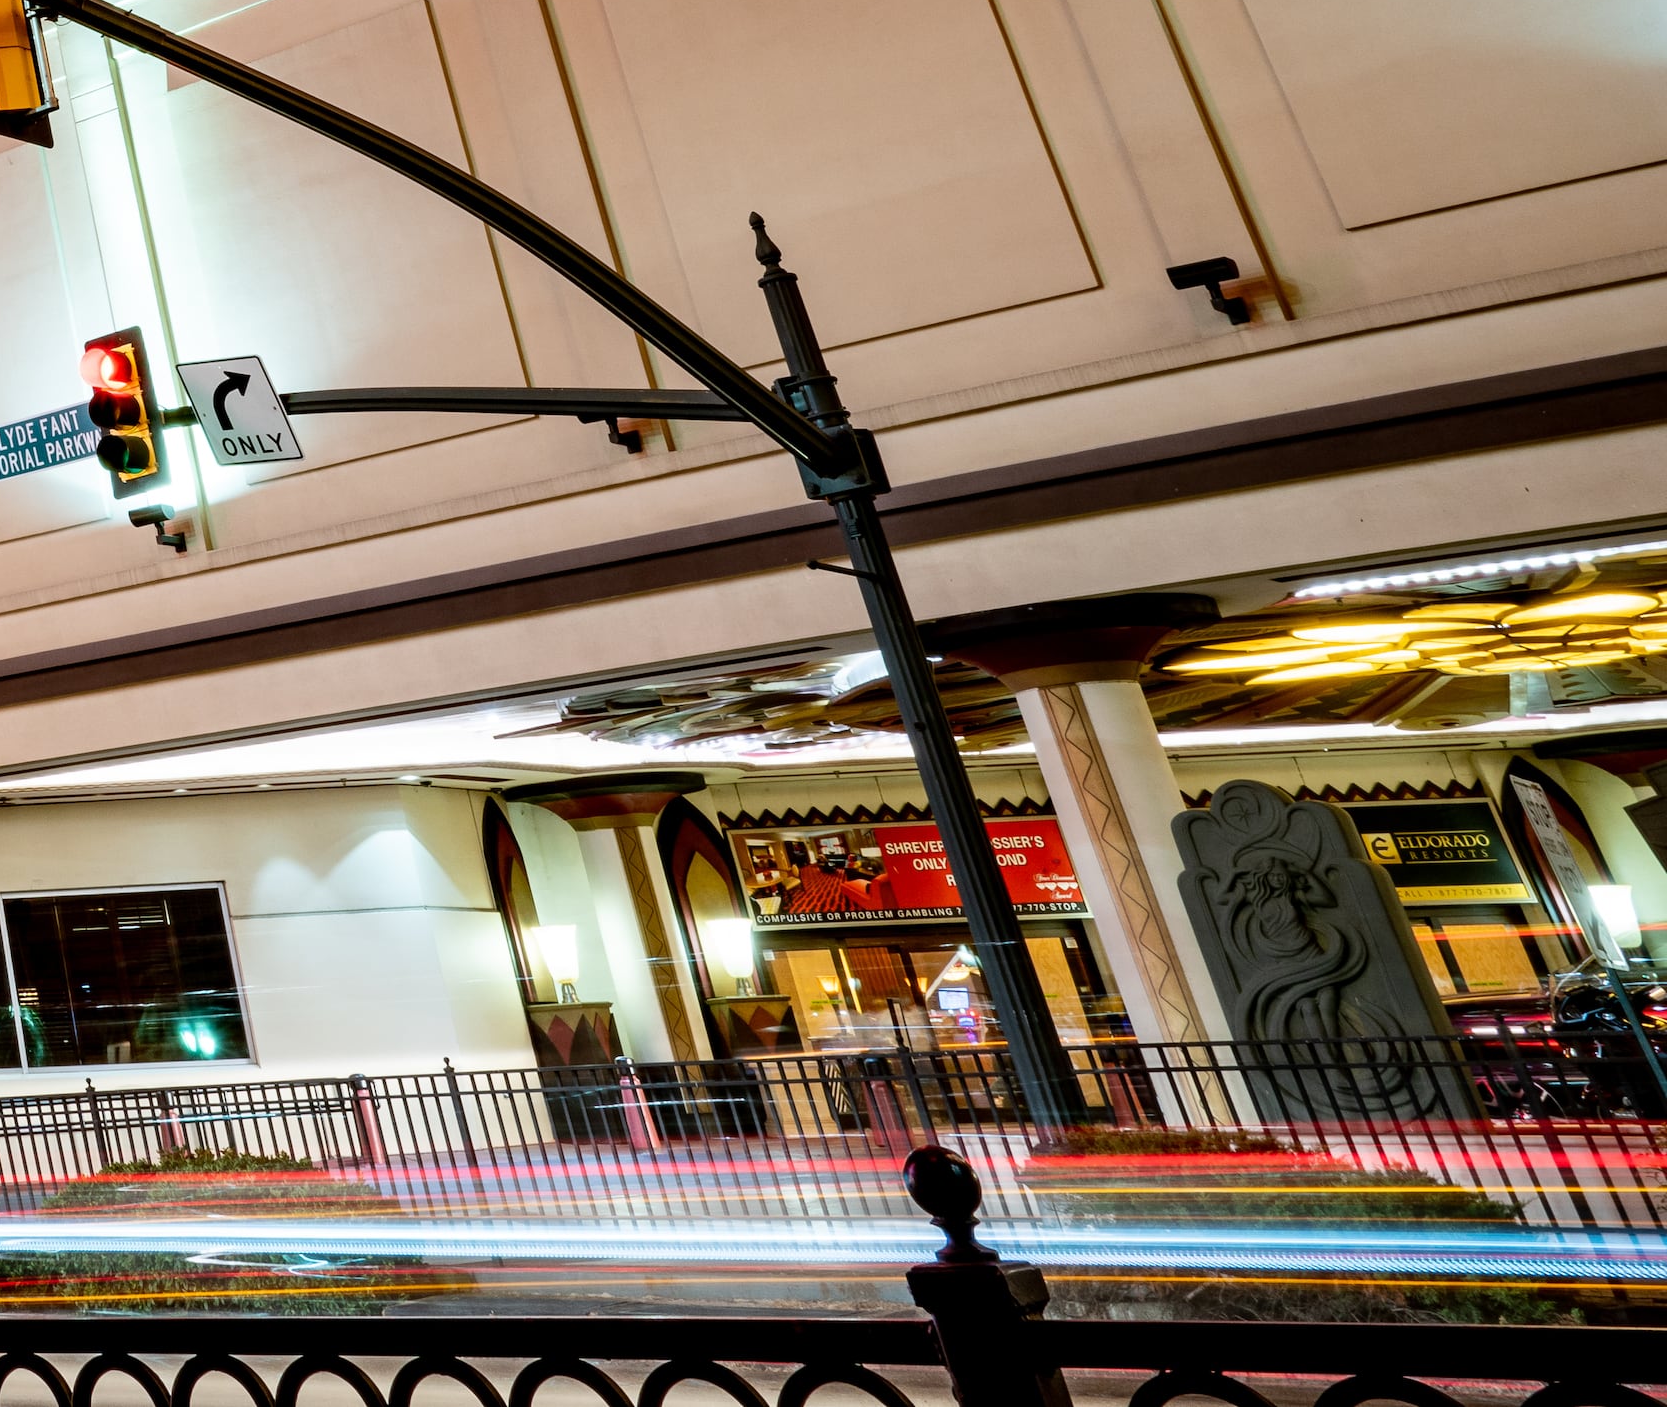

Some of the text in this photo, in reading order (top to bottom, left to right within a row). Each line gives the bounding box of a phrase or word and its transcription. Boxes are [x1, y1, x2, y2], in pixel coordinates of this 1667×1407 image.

[39, 409, 80, 440] FANT
[45, 429, 102, 463] PARKWA
[222, 432, 283, 456] ONLY
[990, 835, 1045, 850] SSIER'S
[1397, 834, 1490, 849] ELDORADO
[1410, 849, 1489, 860] RESORTS
[913, 857, 947, 871] ONLY
[1398, 890, 1424, 898] CALL
[756, 914, 823, 924] COMPULSIVE
[827, 912, 841, 921] OR
[845, 909, 894, 920] PROBLEM
[898, 907, 953, 918] GAMBLING
